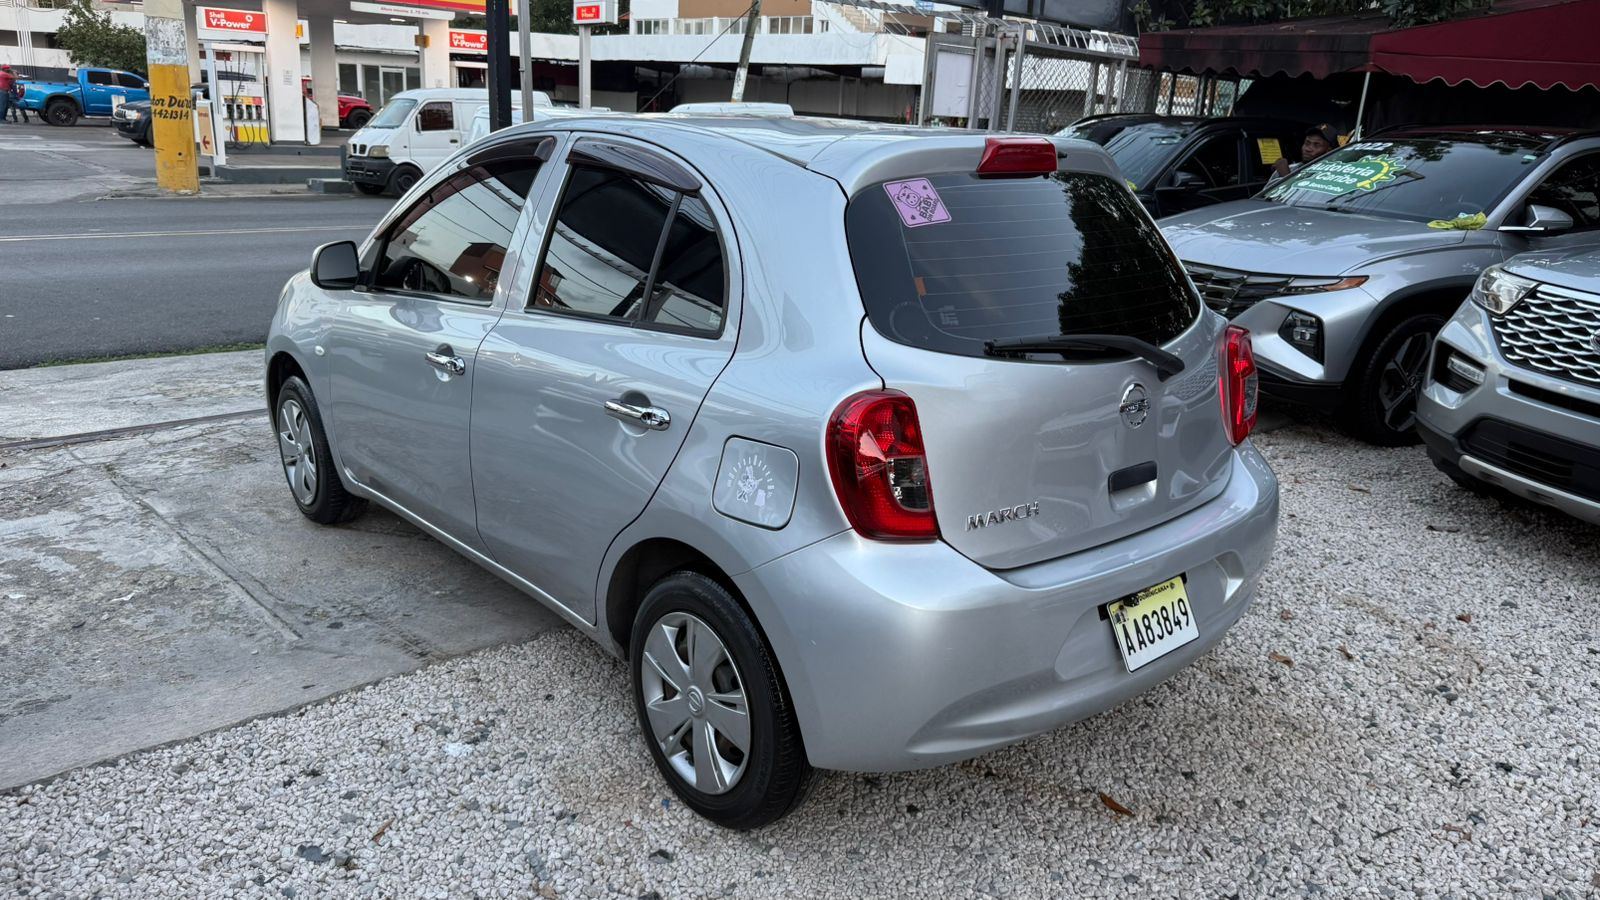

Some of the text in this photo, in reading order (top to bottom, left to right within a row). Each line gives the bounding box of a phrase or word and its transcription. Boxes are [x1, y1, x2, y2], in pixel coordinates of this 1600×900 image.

[210, 18, 251, 29] V-Power
[452, 39, 485, 48] V-Power
[1307, 162, 1375, 177] Autoferia
[1316, 171, 1358, 184] Caribe
[919, 194, 933, 219] BABY
[965, 501, 1039, 532] MARCH
[1122, 597, 1189, 656] AA83849
